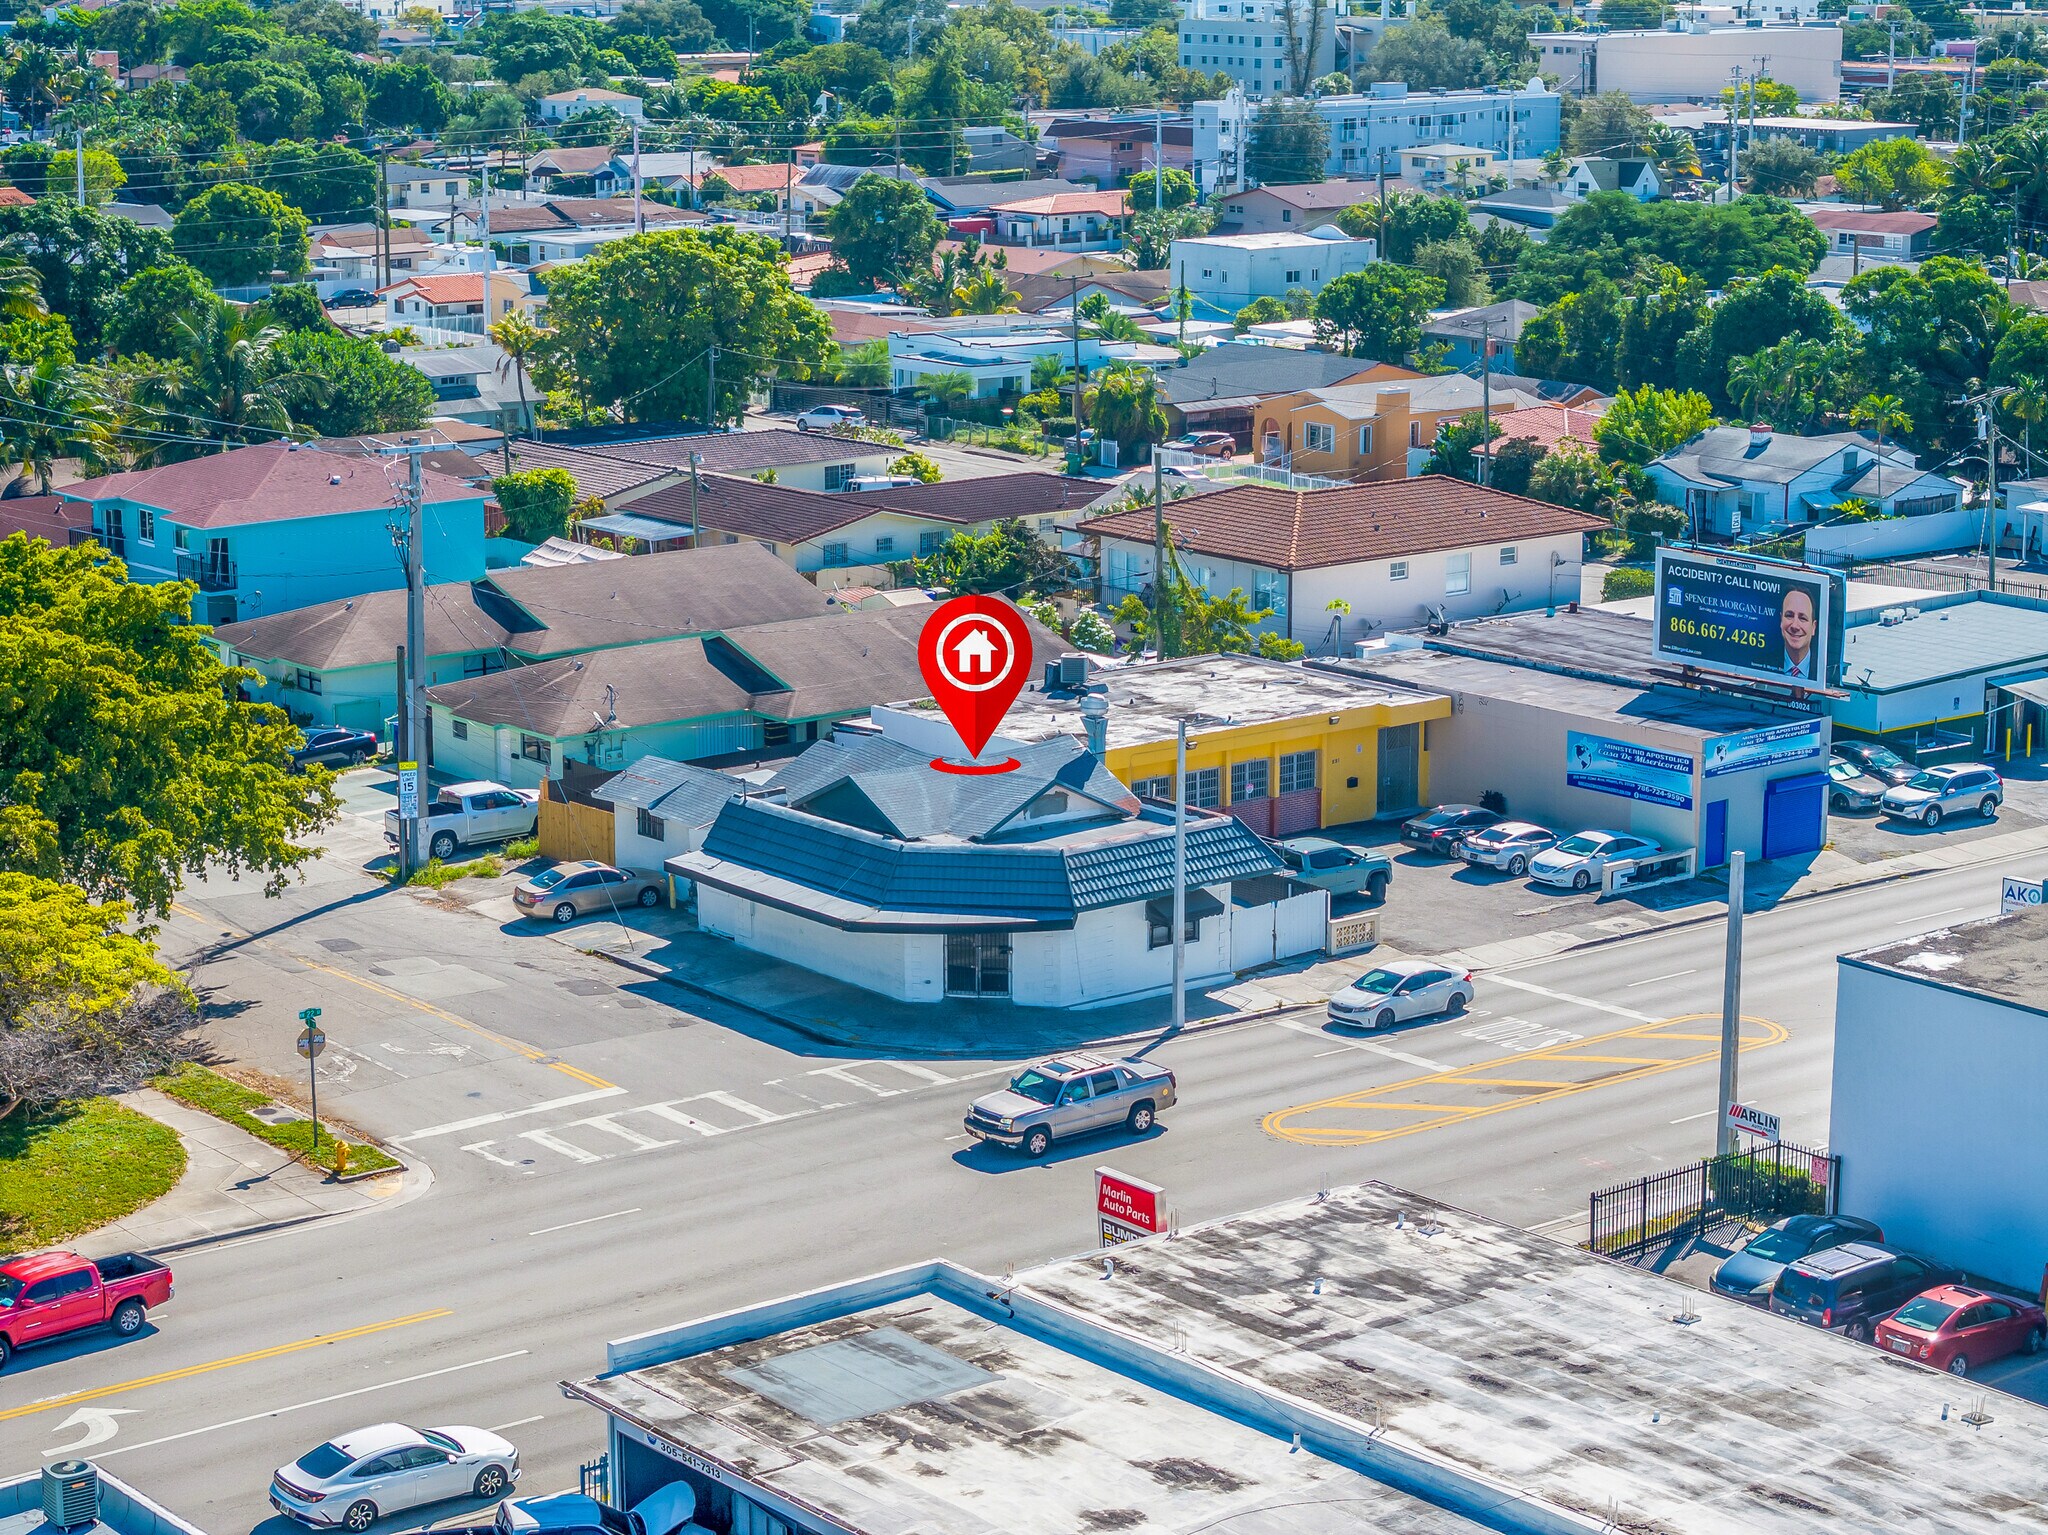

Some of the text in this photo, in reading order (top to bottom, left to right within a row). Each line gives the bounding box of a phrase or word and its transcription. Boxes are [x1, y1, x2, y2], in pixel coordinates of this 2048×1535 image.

[1668, 565, 1780, 593] ACCIDENT? CALL NOW!
[1685, 593, 1776, 616] SPENCER MORGAN LAW
[1671, 617, 1765, 648] 866.667.4265
[1776, 724, 1810, 734] APOSTOLICO
[1598, 749, 1619, 758] Casa
[1635, 756, 1689, 772] Misericordia
[1605, 743, 1689, 764] MINISTERIO APOSTOLICO
[403, 782, 414, 792] 15
[1637, 784, 1685, 803] 786-724-9590
[2005, 885, 2040, 904] AKO
[1102, 1184, 1132, 1204] Marlin
[1103, 1197, 1150, 1225] Auto Parts
[1103, 1222, 1142, 1242] BUMP
[660, 1442, 721, 1479] 305-541-7313
